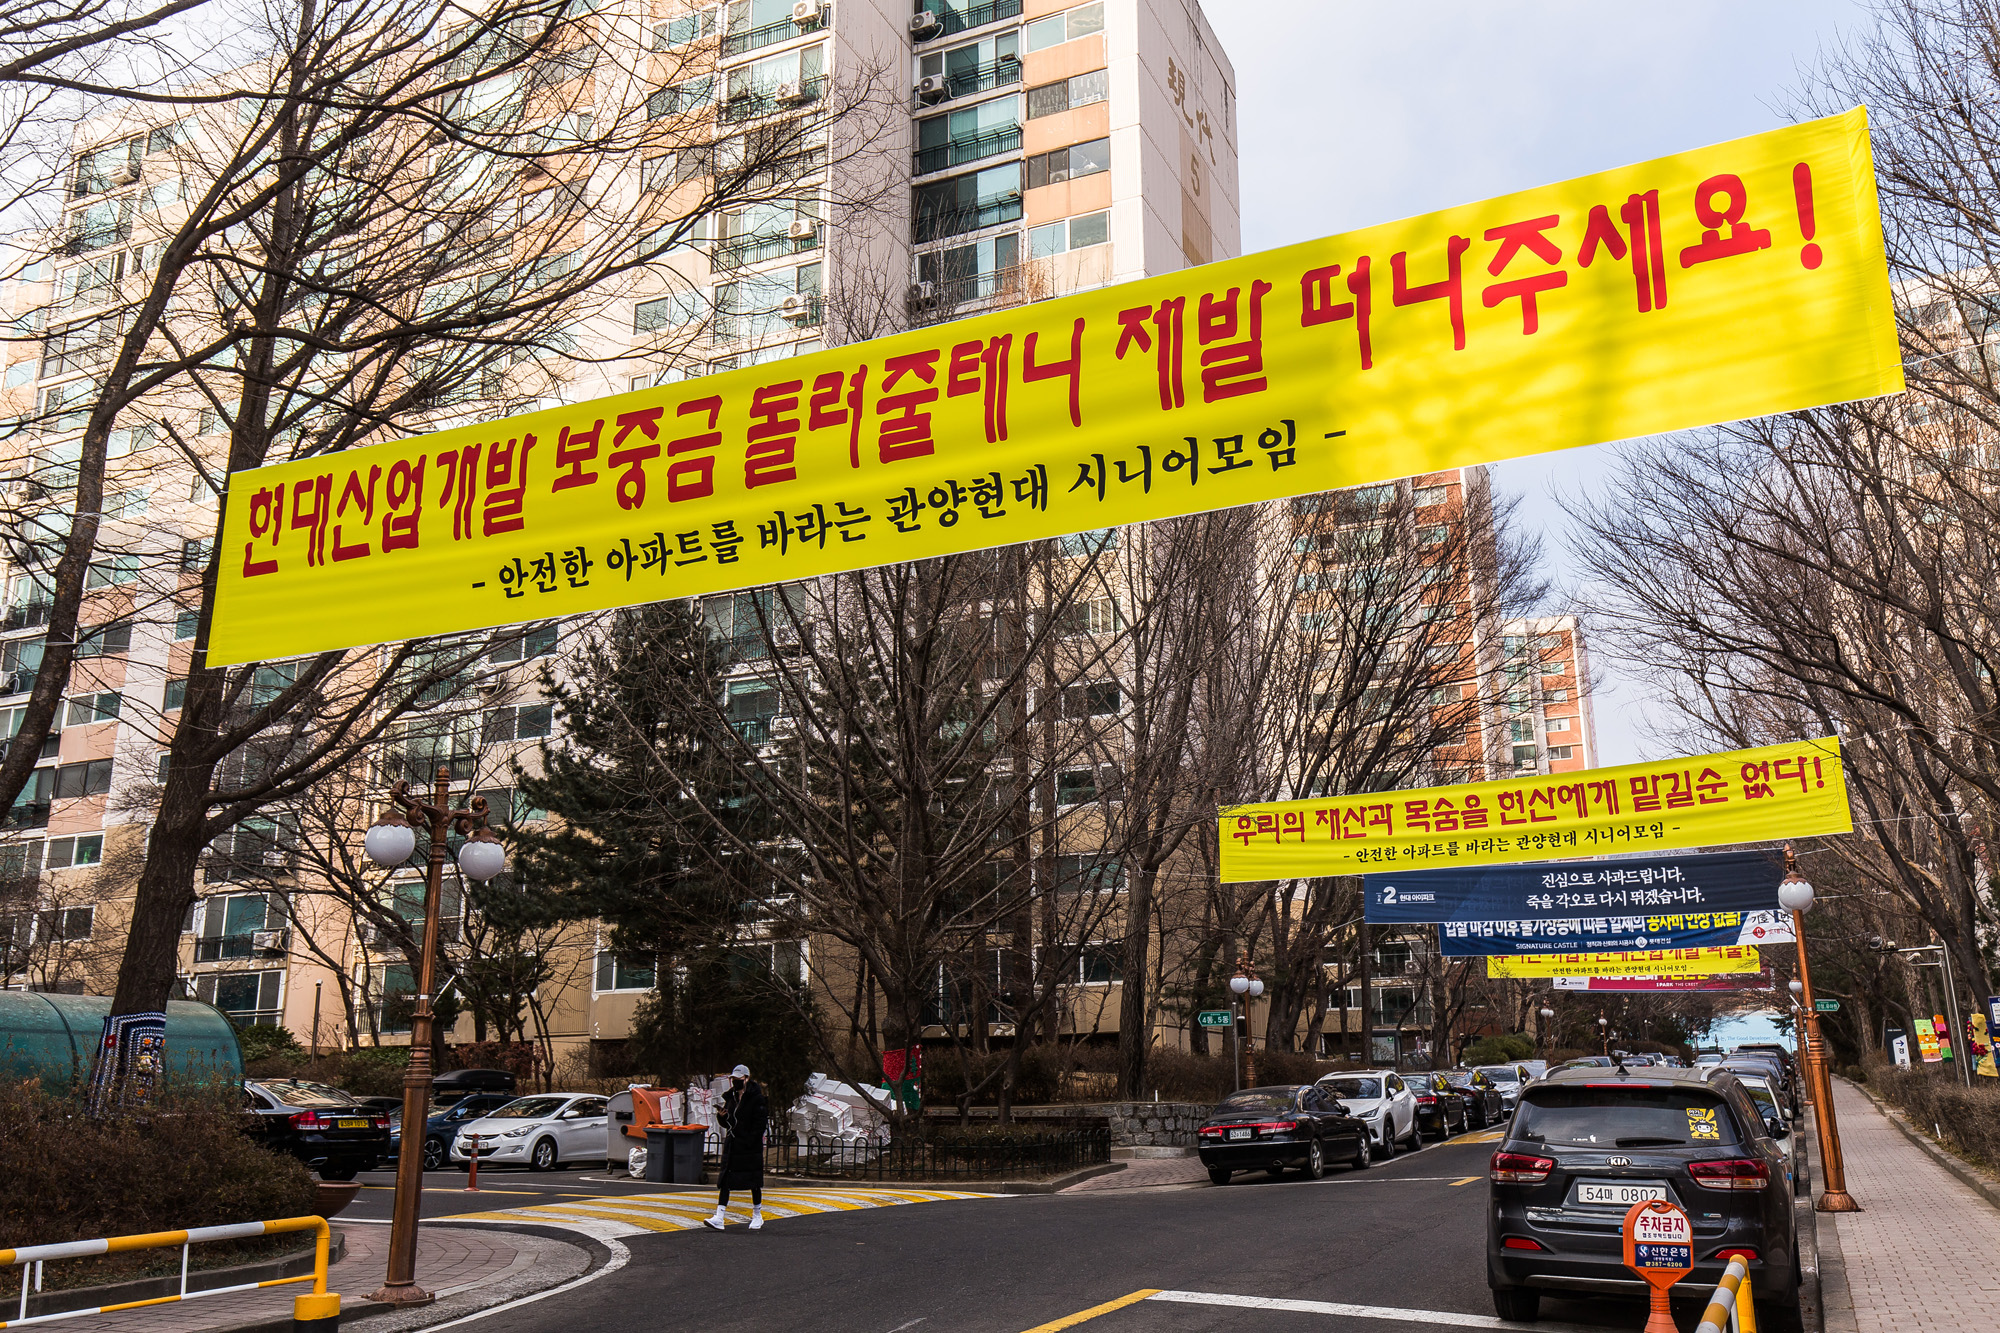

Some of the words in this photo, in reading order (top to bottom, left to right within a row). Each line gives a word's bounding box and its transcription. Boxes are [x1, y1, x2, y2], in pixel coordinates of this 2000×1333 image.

[1190, 153, 1201, 197] 5
[243, 434, 537, 577] 현대산업개발
[745, 318, 1085, 489] 돌려줄테니
[1116, 279, 1272, 410] 제발
[499, 547, 593, 598] 안전한
[607, 520, 744, 581] 아파트를
[757, 502, 871, 556] 바라는
[885, 464, 1047, 532] 관양현대
[1068, 420, 1296, 502] 시니어모임
[1233, 812, 1304, 846] 우리의
[1316, 804, 1393, 840] 재산과
[1405, 795, 1488, 832] 목숨을
[1498, 779, 1619, 825] 현산에게
[1741, 756, 1824, 799] 없다!
[1356, 846, 1397, 863] 안전한
[1403, 841, 1460, 860] 아파트를
[1466, 837, 1510, 855] 바라는
[1516, 830, 1577, 851] 관양현대
[1584, 821, 1664, 845] 시니어모임
[1541, 871, 1597, 889] 진심으로
[1597, 866, 1686, 886] 사과드립니다.
[1383, 886, 1397, 904] 2
[1526, 893, 1554, 910] 죽을
[1556, 892, 1598, 909] 각오로
[1599, 889, 1627, 907] 다시
[1630, 886, 1706, 906] 뛰겠습니다.
[1515, 942, 1553, 950] SIGNATURE
[1553, 941, 1578, 949] CASTLE
[1610, 1157, 1628, 1166] KIA
[1586, 1187, 1613, 1201] 54마
[1621, 1188, 1658, 1202] 0802
[1640, 1216, 1684, 1233] 주차금지
[1651, 1247, 1688, 1258] 신한은행
